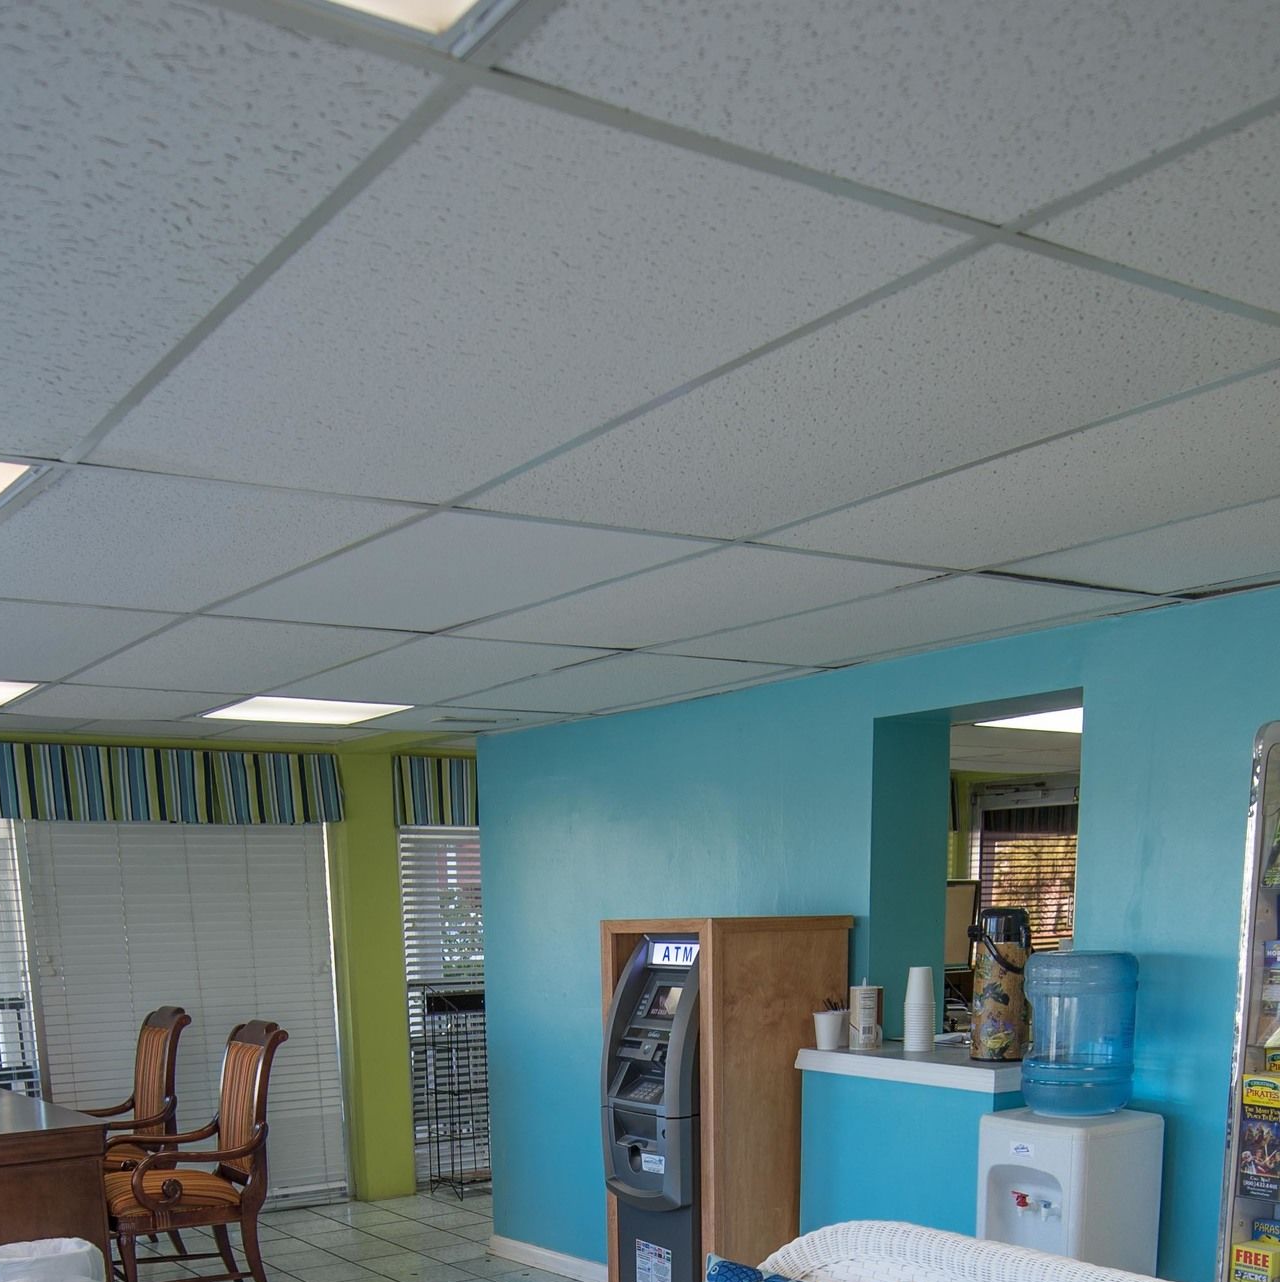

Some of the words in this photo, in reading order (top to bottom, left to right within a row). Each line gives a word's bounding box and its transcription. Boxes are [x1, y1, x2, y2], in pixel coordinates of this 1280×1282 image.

[662, 945, 693, 963] ATM
[1246, 1088, 1280, 1099] PIRATES
[1235, 1248, 1270, 1269] FREE
